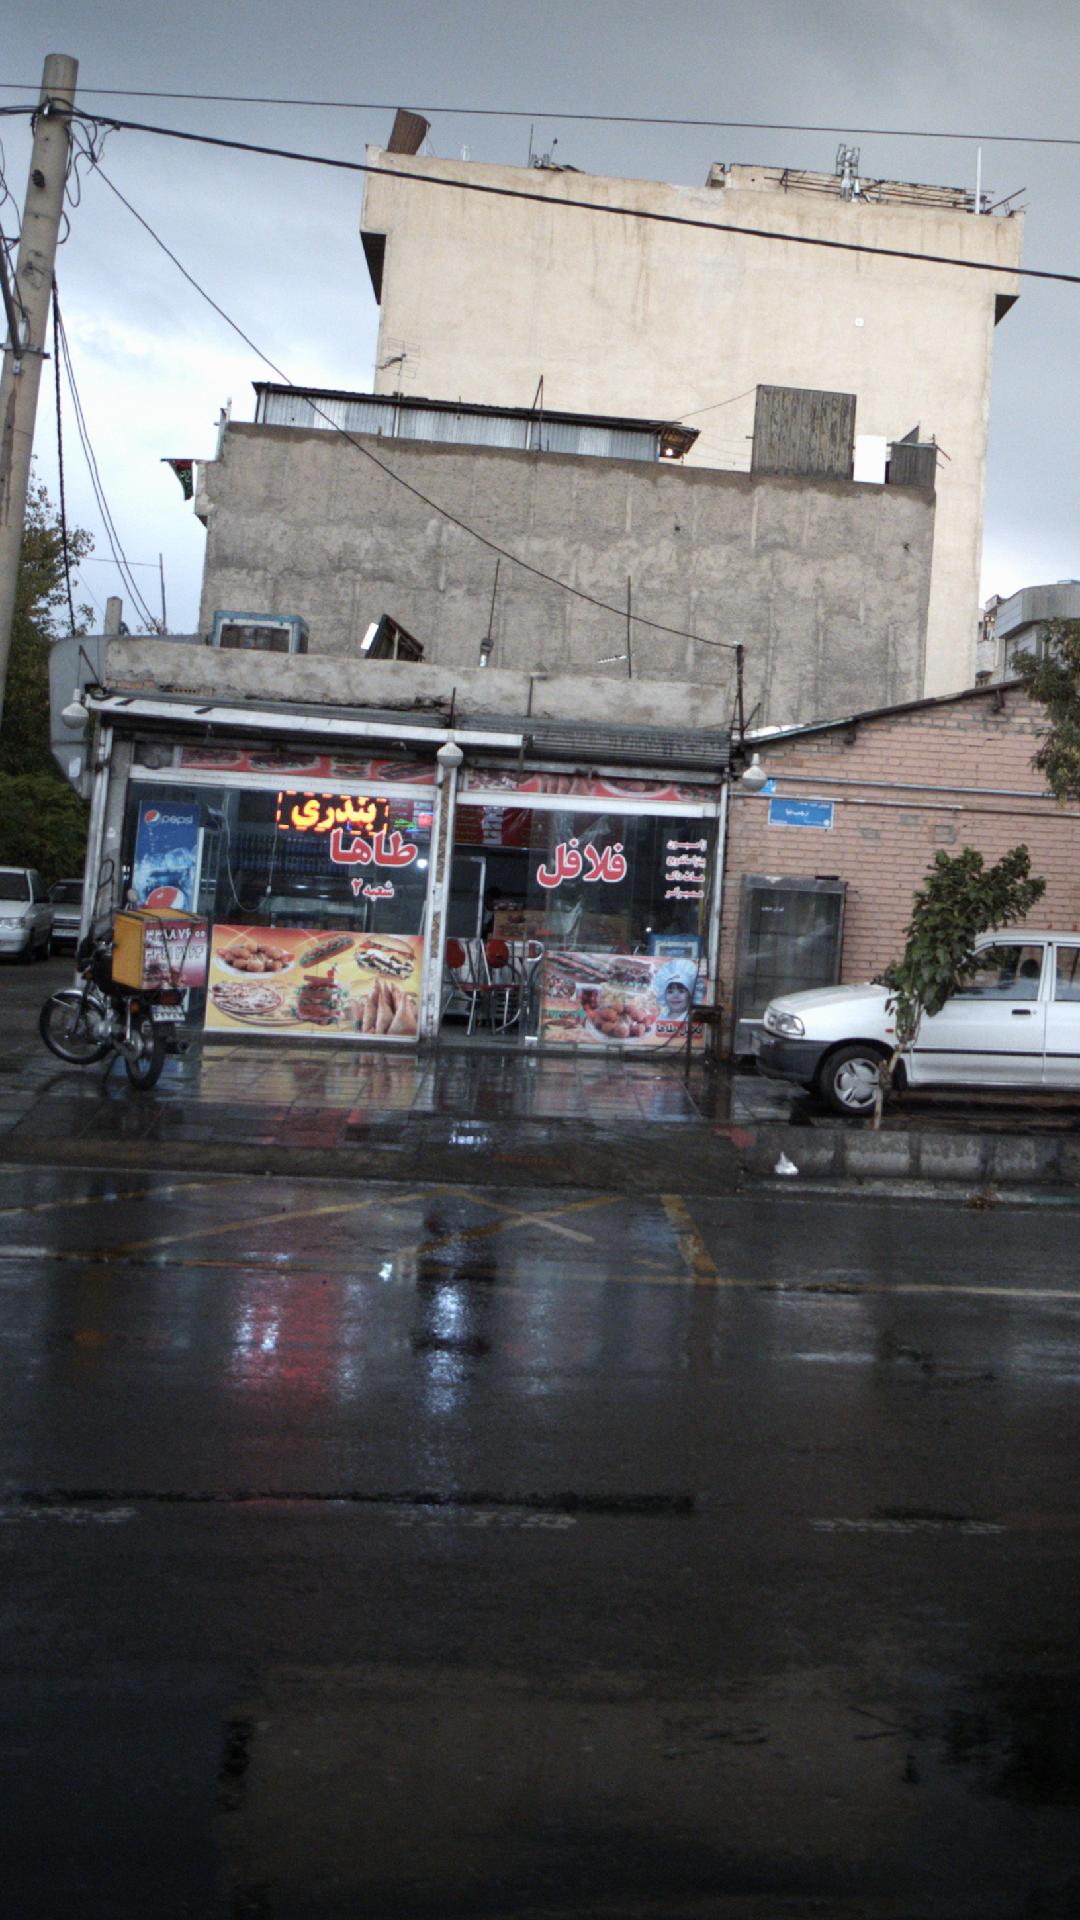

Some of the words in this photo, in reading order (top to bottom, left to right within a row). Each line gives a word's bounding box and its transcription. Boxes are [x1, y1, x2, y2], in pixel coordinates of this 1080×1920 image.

[160, 814, 194, 825] pepsi
[291, 797, 377, 831] بندری
[330, 827, 418, 867] طاها
[536, 838, 628, 889] فلافل
[350, 877, 363, 897] ۲
[362, 880, 395, 901] شعبه
